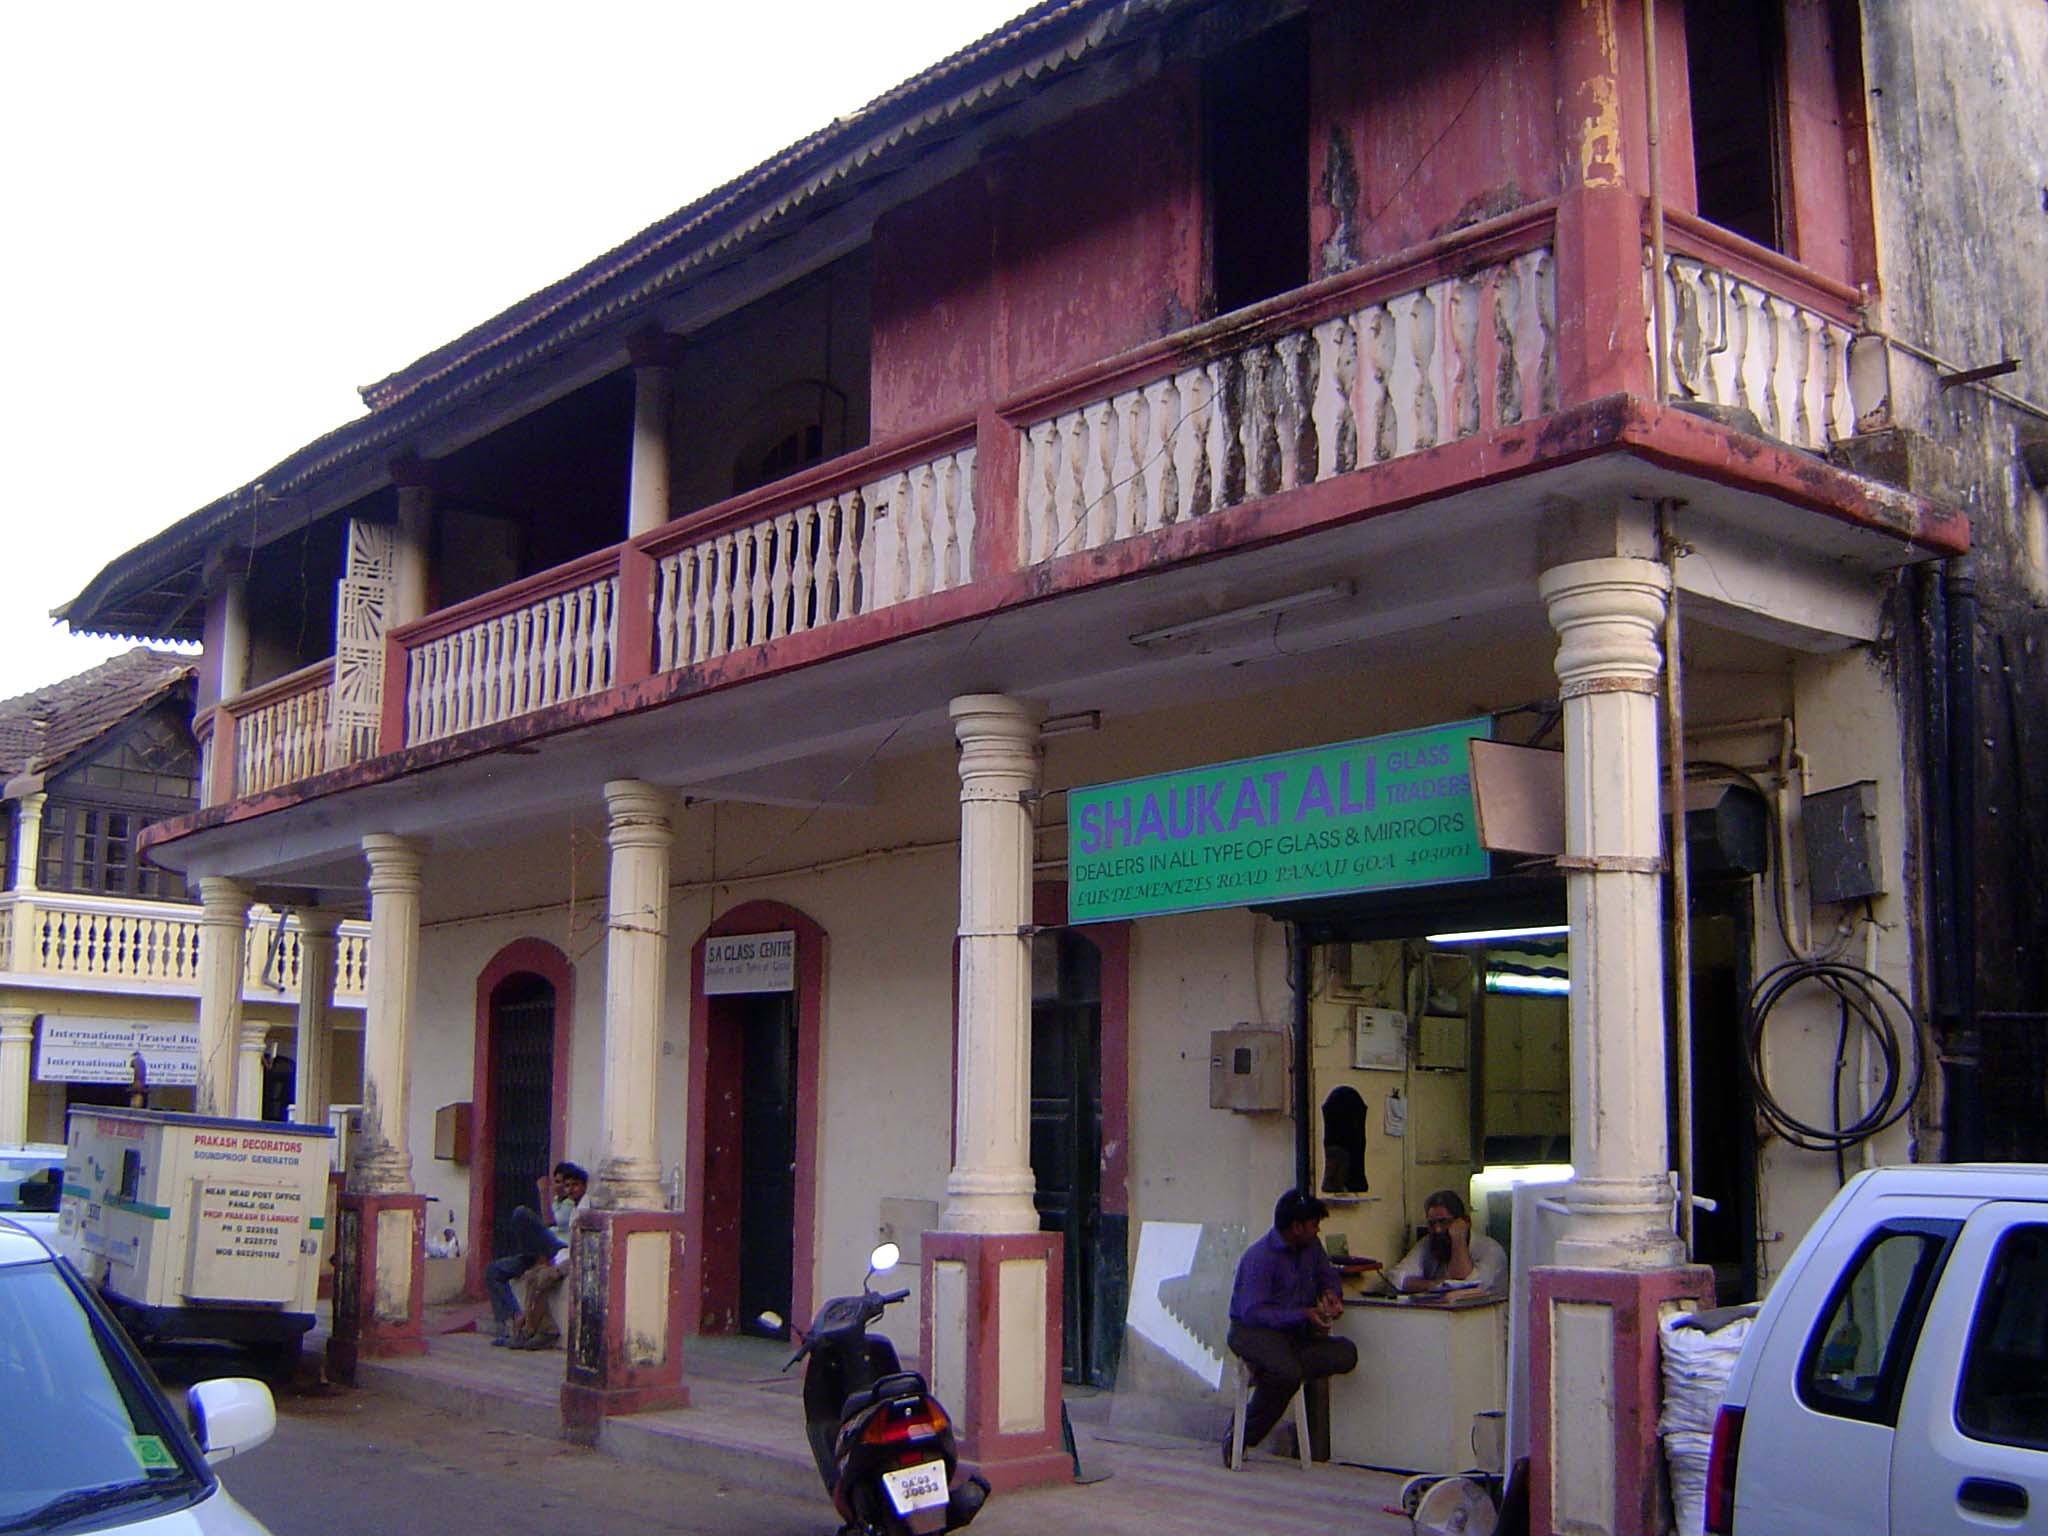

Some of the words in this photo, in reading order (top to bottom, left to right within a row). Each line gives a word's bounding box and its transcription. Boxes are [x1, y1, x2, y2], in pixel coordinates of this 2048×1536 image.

[1386, 743, 1450, 773] GLASS
[1385, 772, 1471, 805] TRADERS
[1079, 770, 1288, 854] SHAUKAT
[1295, 755, 1377, 823] ALI
[1076, 856, 1144, 882] DEALERS
[1150, 853, 1166, 871] IN
[1169, 848, 1199, 868] ALL
[1203, 842, 1243, 863] TYPE
[1247, 835, 1274, 859] OF
[1277, 829, 1341, 855] GLASS
[1344, 826, 1360, 846] &
[1364, 812, 1465, 844] MIRRORS
[1216, 869, 1269, 889] ROAD
[1275, 859, 1349, 882] PANAJI
[1353, 853, 1397, 876] GOA
[1406, 843, 1473, 866] 403001
[50, 1029, 135, 1041] International
[139, 1033, 176, 1043] Travel
[47, 1057, 127, 1069] International
[194, 1135, 238, 1149] PRAKASH
[242, 1139, 302, 1154] DECORATORS
[194, 1150, 248, 1162] SOUNDPROOF
[251, 1154, 300, 1166] GENERATOR
[205, 1187, 226, 1196] NEAR
[252, 1191, 272, 1200] POST
[275, 1193, 301, 1202] OFFICE
[225, 1211, 258, 1221] PRAKASH
